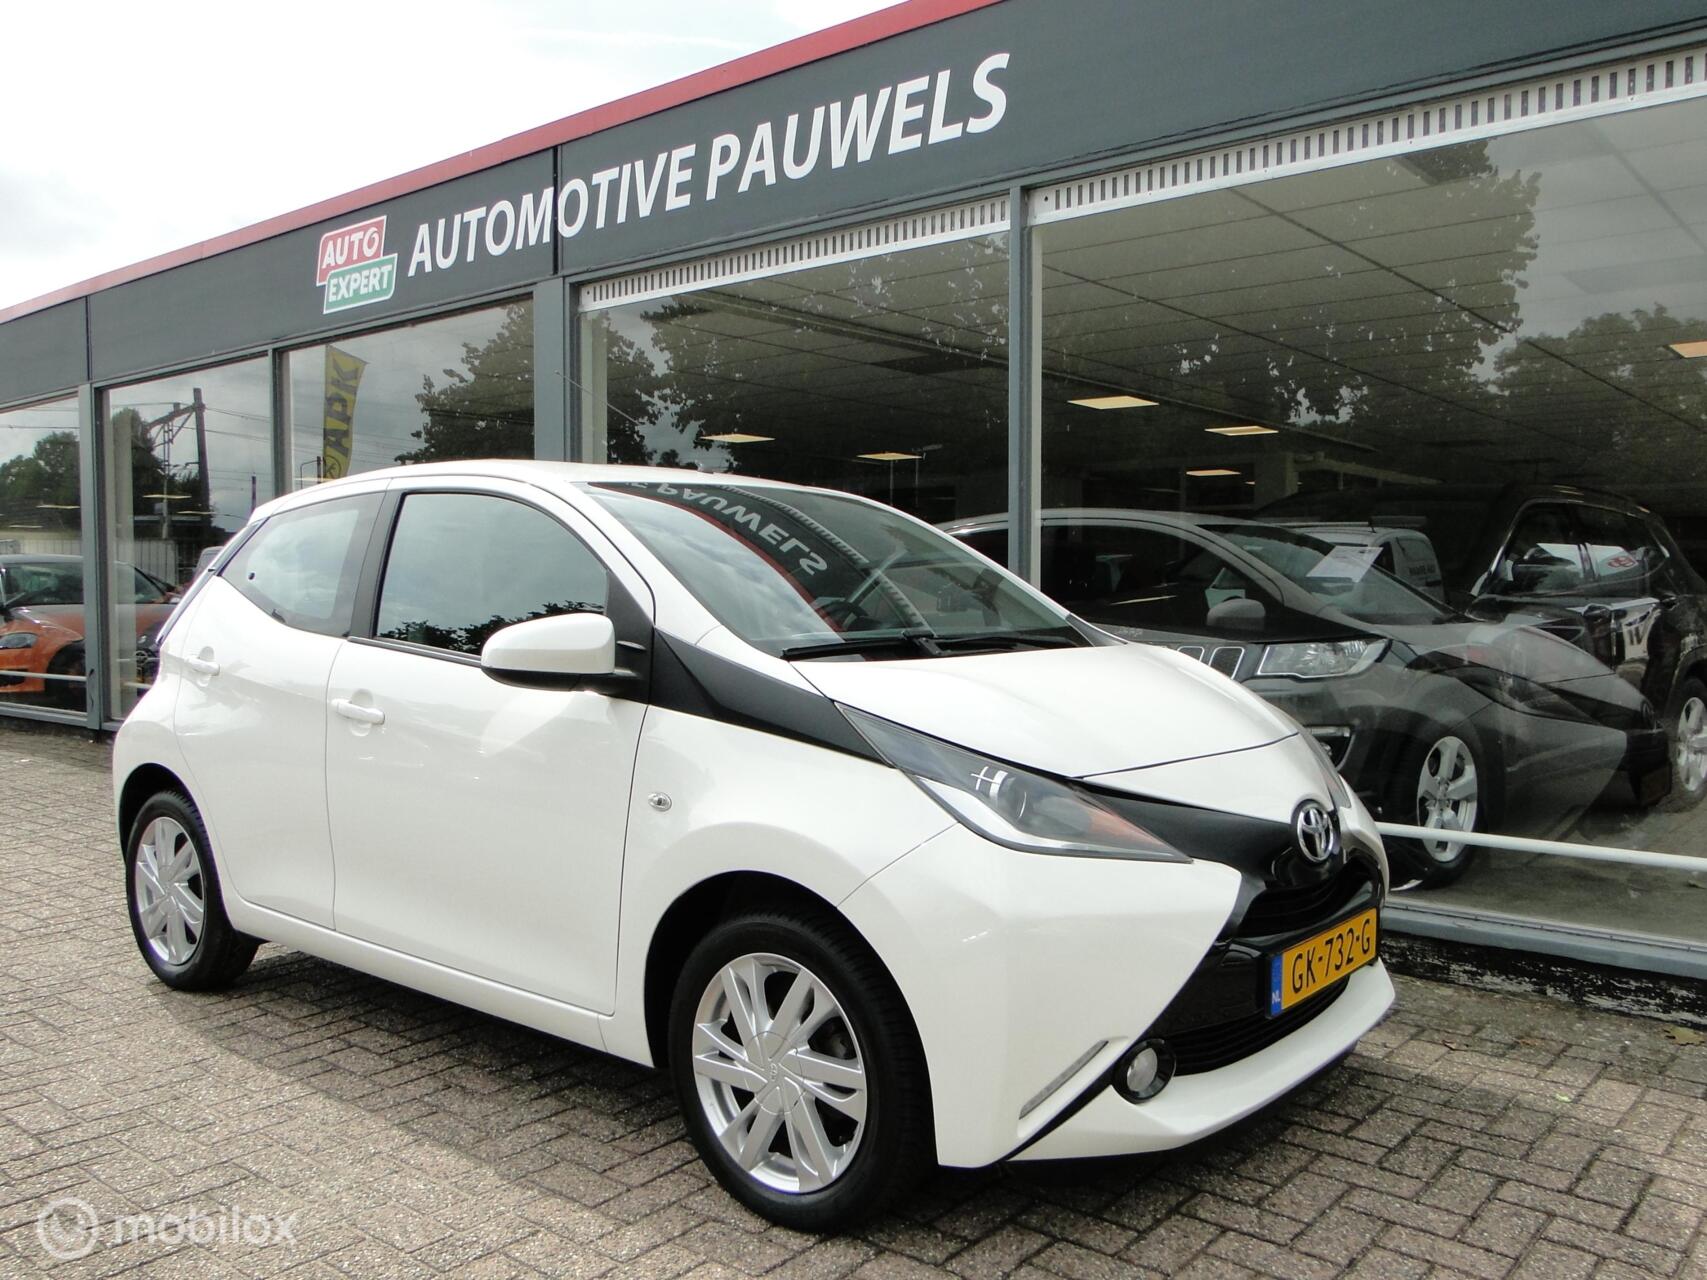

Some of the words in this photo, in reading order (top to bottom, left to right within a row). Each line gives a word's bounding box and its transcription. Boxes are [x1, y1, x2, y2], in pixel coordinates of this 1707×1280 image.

[408, 144, 697, 278] AUTOMOTIVE
[705, 52, 1011, 202] PAUWELS
[321, 227, 380, 269] AUTO
[328, 264, 393, 303] EXPERT
[324, 351, 359, 459] APK
[1291, 918, 1371, 994] GK-732-G
